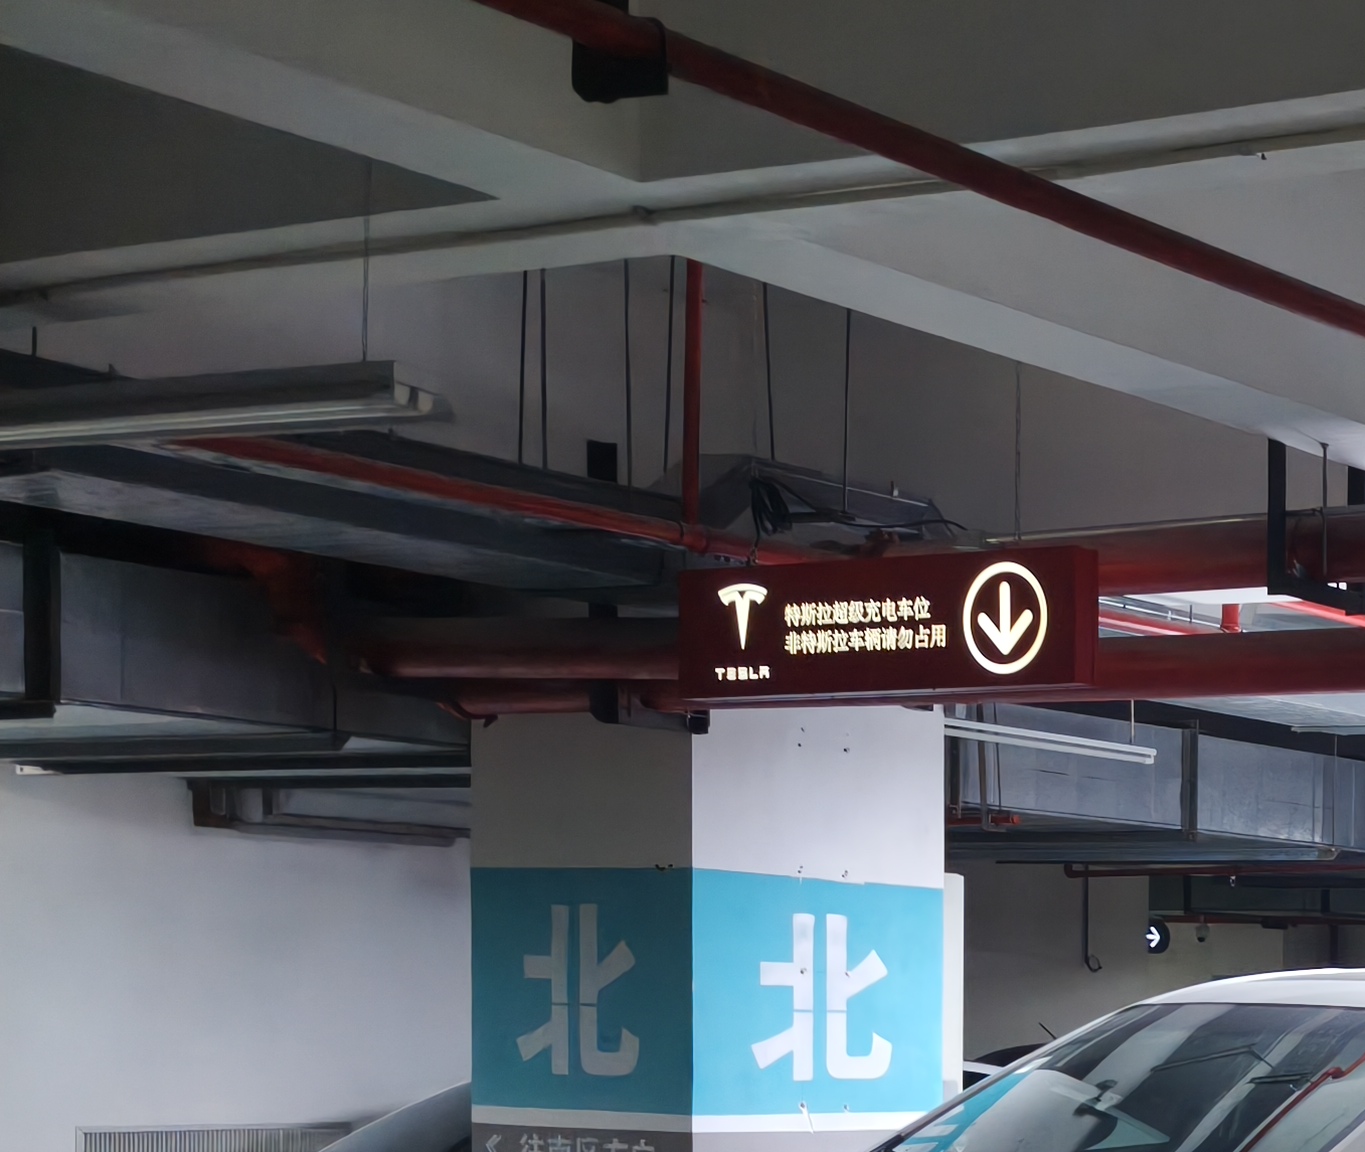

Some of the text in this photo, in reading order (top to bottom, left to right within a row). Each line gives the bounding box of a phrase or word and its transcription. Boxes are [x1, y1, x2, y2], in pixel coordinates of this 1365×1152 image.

[784, 597, 931, 627] 特斯拉超级充电车位
[784, 624, 947, 655] 非特斯拉车辆请勿占用
[714, 665, 771, 681] TESLA
[516, 903, 640, 1076] 北
[751, 913, 893, 1082] 北
